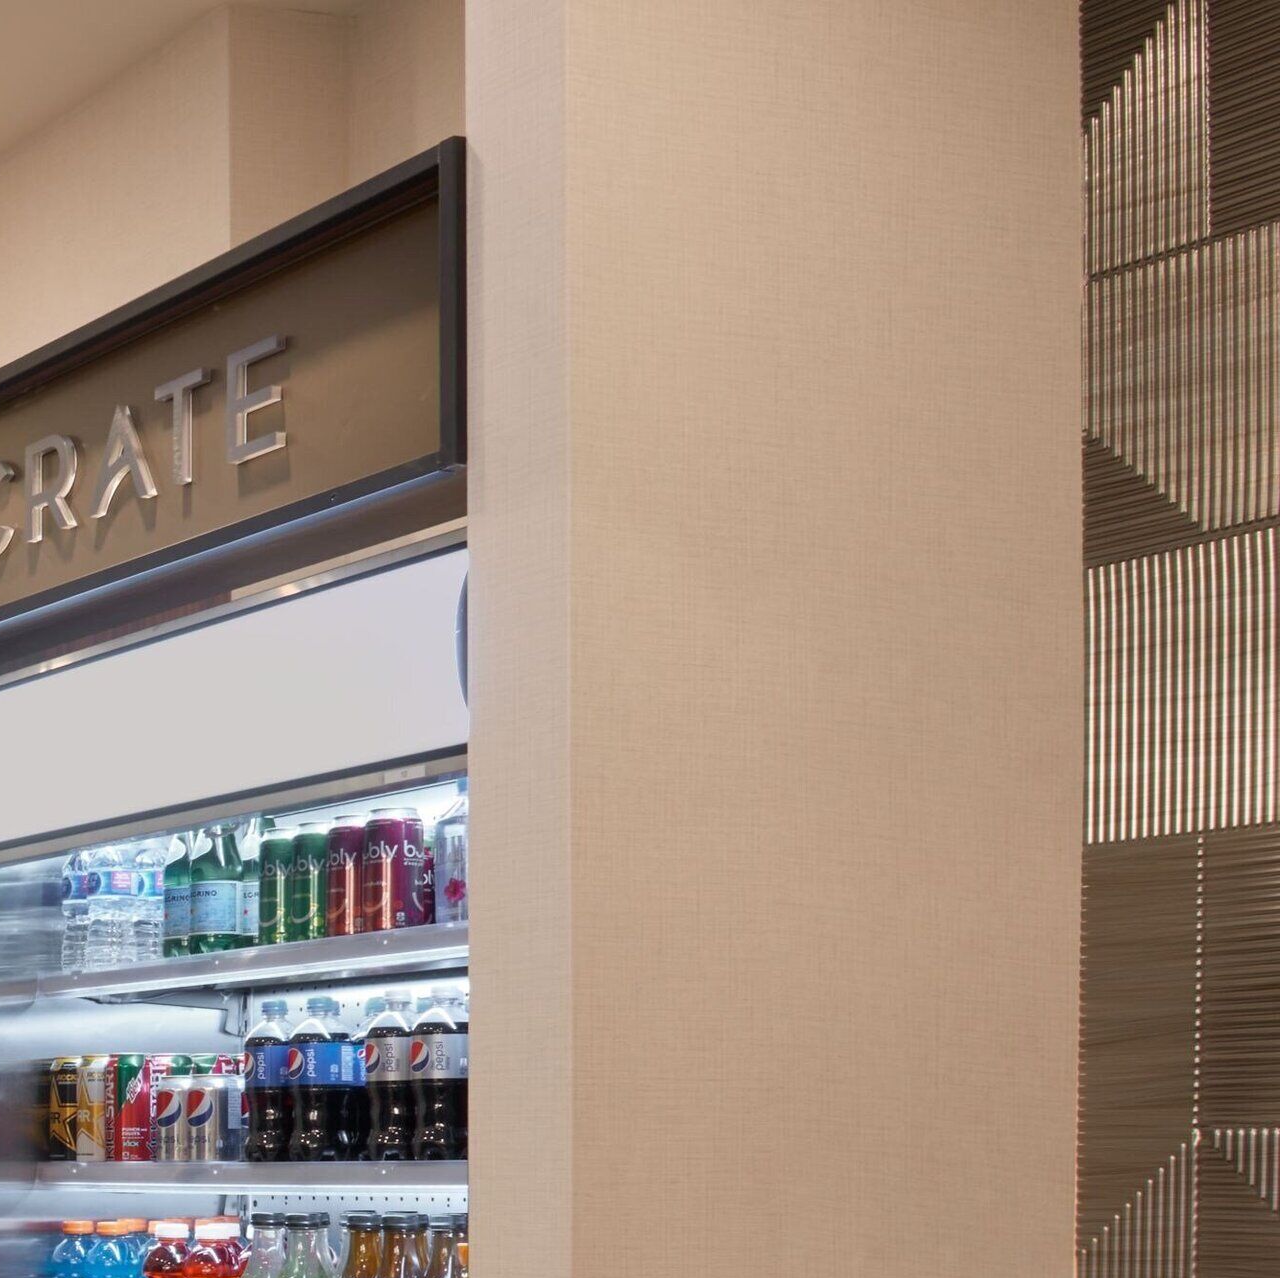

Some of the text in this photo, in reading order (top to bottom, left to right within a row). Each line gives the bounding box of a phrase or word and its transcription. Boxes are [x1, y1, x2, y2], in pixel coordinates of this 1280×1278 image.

[257, 1052, 266, 1080] pepsi
[306, 1049, 316, 1077] pepsi
[385, 1043, 395, 1072] pepsi
[436, 1041, 446, 1071] pepsi
